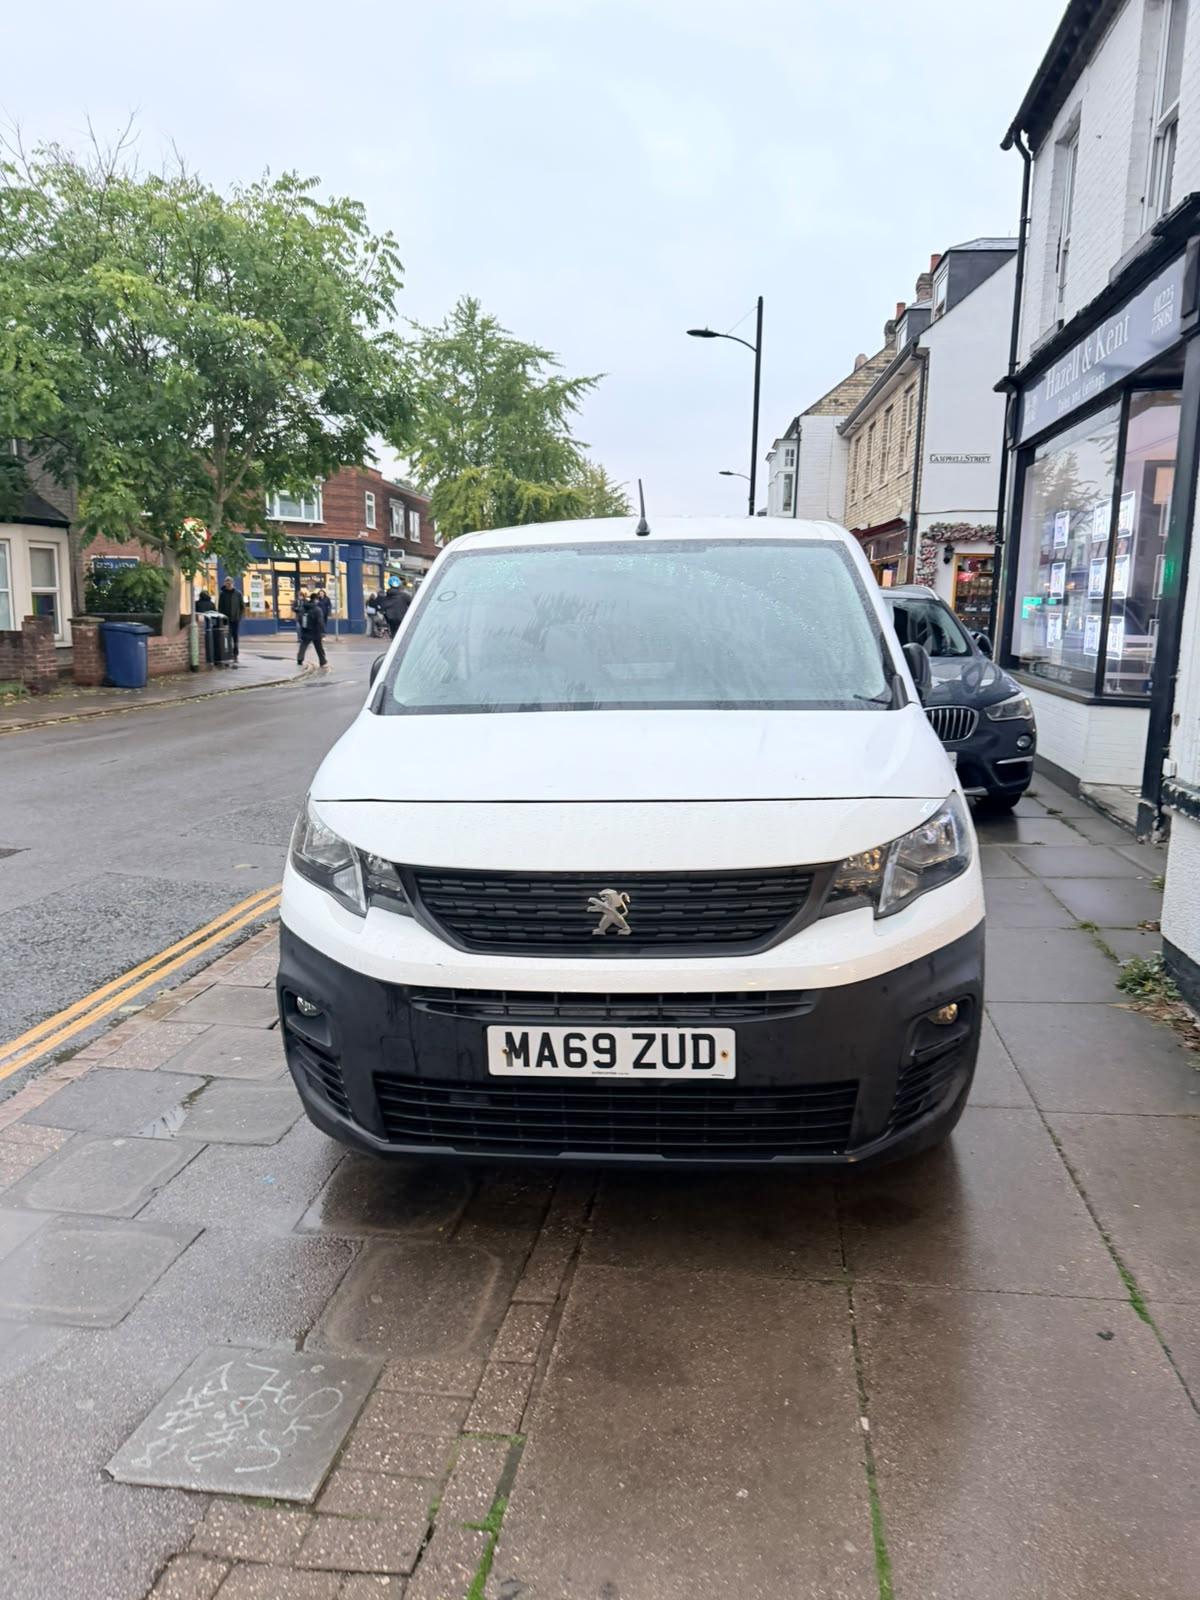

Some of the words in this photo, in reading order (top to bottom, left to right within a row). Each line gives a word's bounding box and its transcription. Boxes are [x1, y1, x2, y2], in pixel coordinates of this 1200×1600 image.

[1043, 345, 1081, 401] Hazell
[1081, 337, 1094, 374] &
[1094, 313, 1131, 366] Kent
[504, 1031, 617, 1069] MA69
[631, 1033, 716, 1070] ZUD
